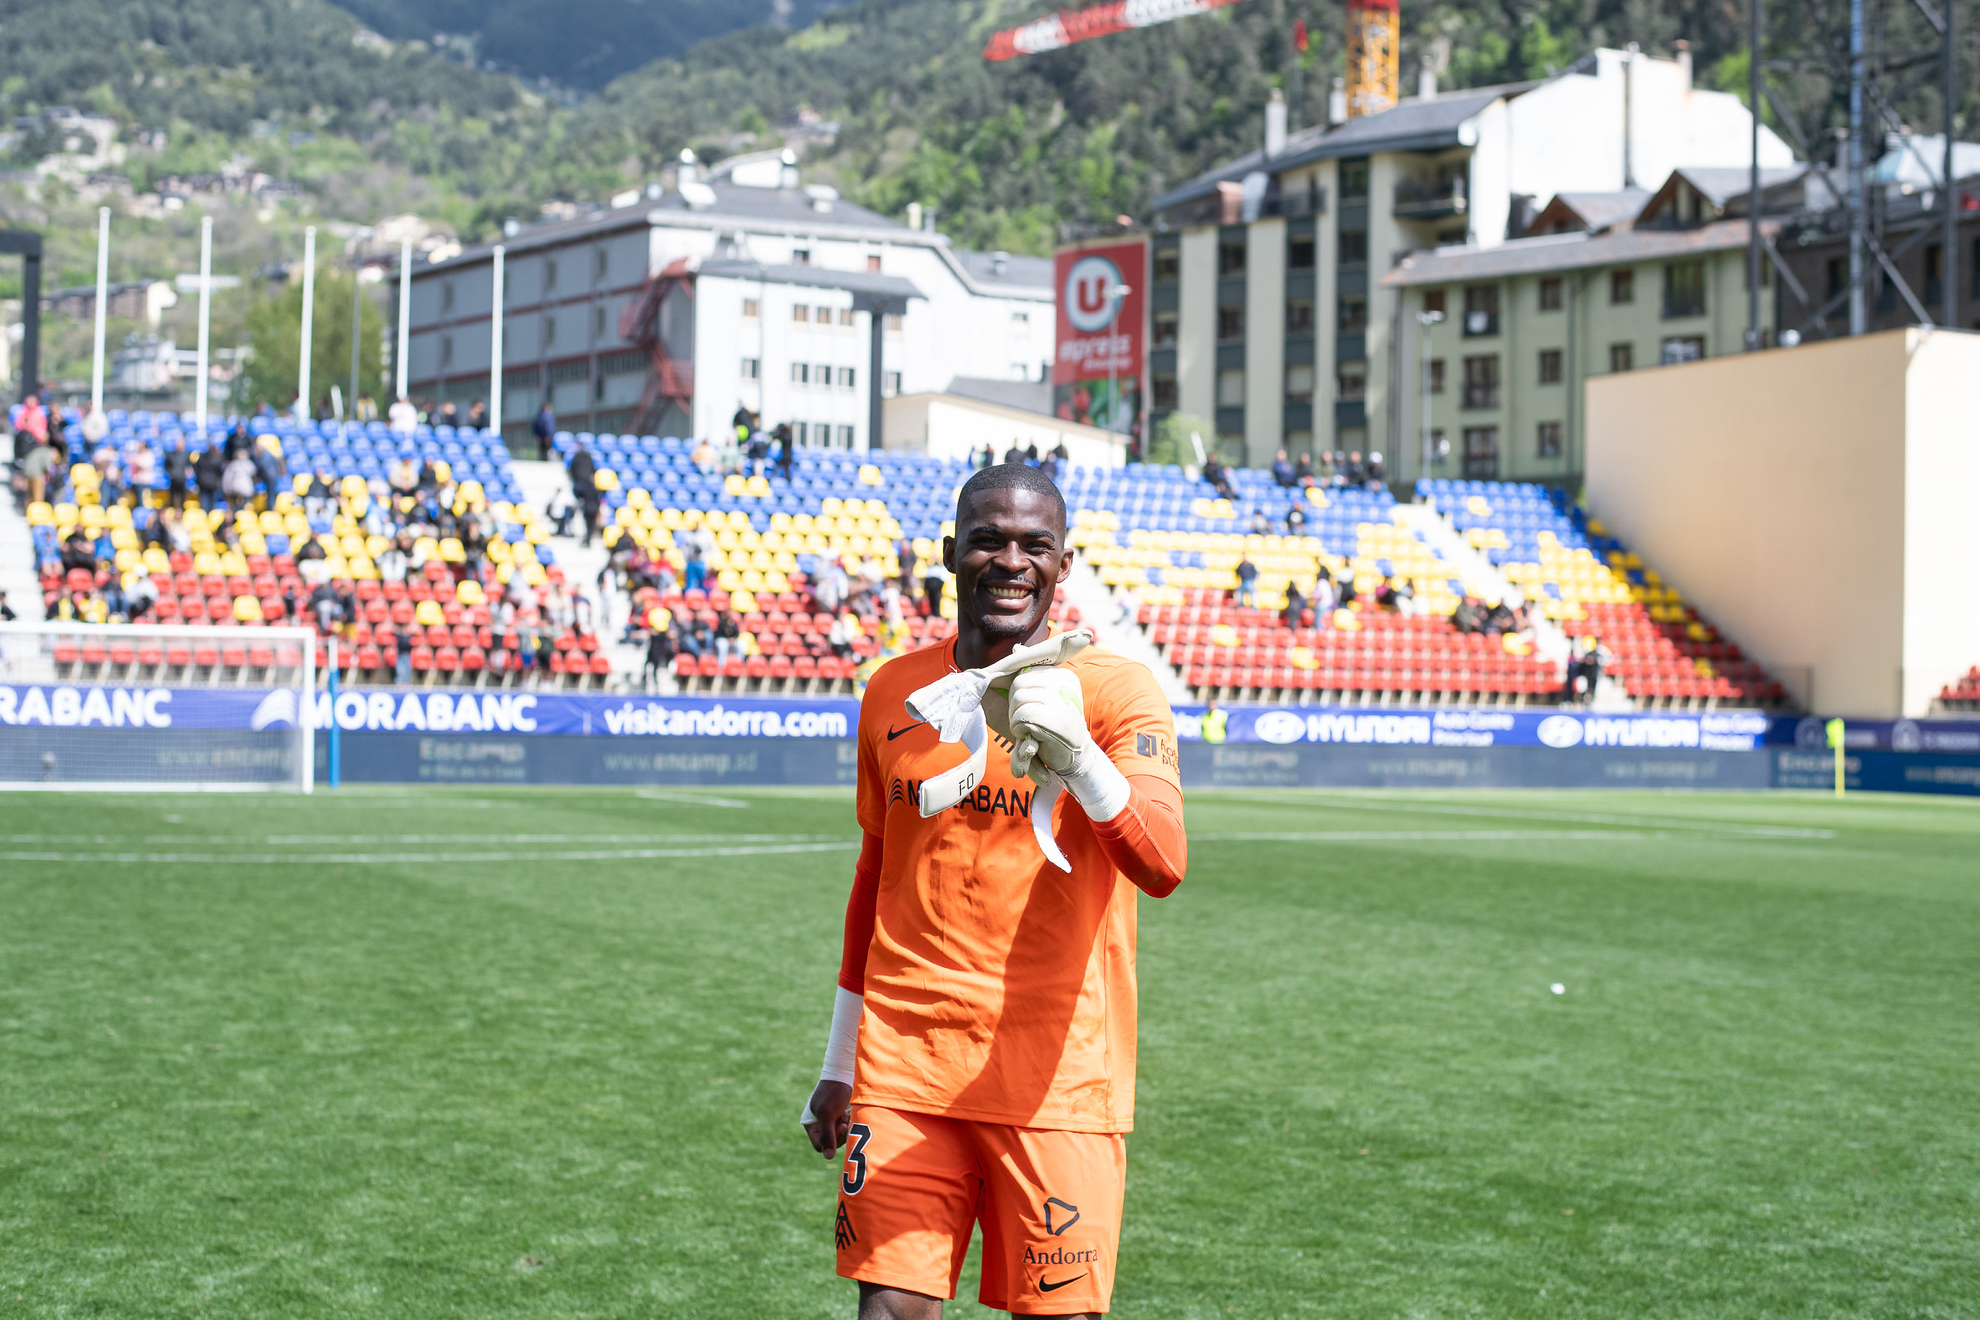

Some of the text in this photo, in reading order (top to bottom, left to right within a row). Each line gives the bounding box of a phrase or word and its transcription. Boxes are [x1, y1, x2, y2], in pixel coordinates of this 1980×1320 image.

[1077, 277, 1107, 315] U
[299, 689, 538, 732] MORABANC
[603, 702, 848, 737] visitandorra.com
[1306, 714, 1431, 744] HYUNDAI
[1584, 718, 1699, 747] HYUNDAI
[907, 780, 1030, 818] MABAN
[842, 1122, 872, 1195] 3
[1022, 1246, 1098, 1265] Andorra
